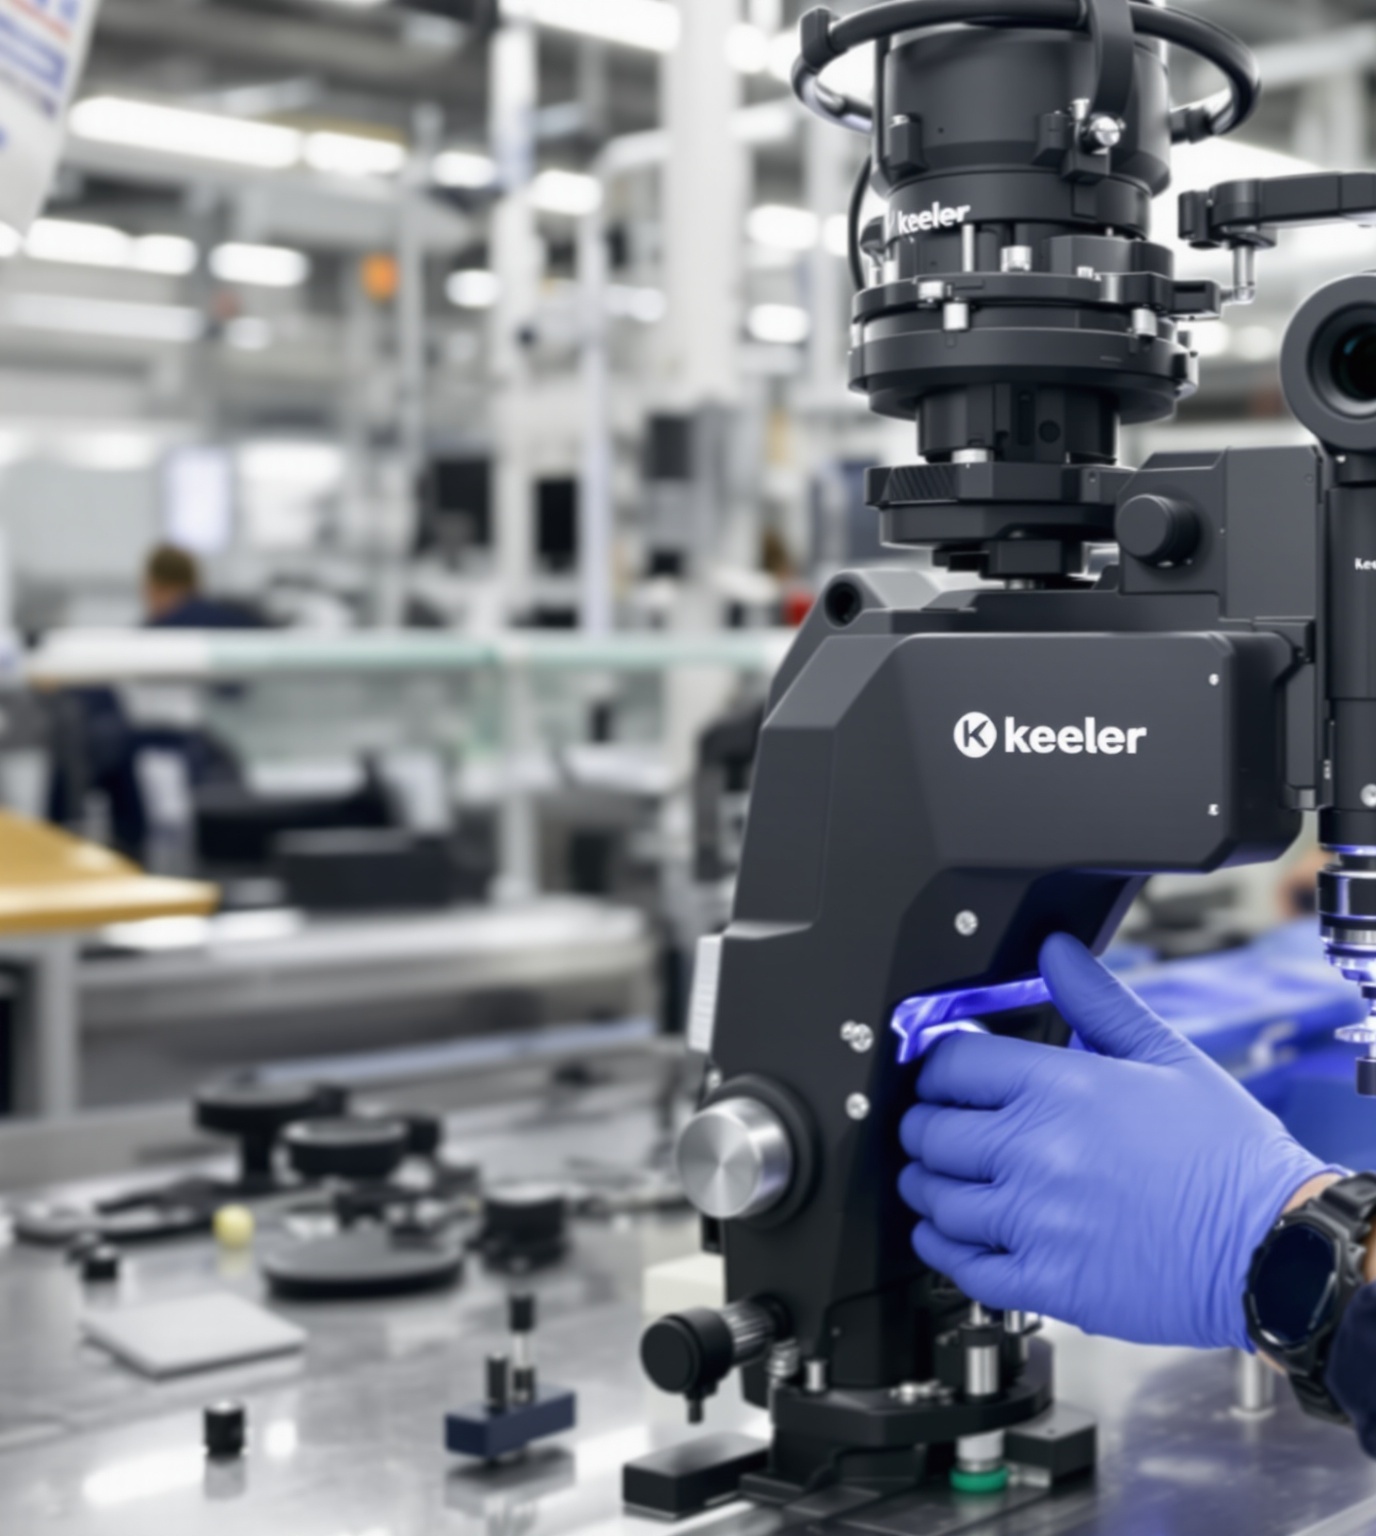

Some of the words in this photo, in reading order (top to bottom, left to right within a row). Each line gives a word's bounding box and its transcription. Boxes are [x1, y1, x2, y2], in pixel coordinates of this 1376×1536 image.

[898, 201, 971, 235] keeler
[953, 711, 998, 759] K
[1005, 716, 1147, 754] keeler
